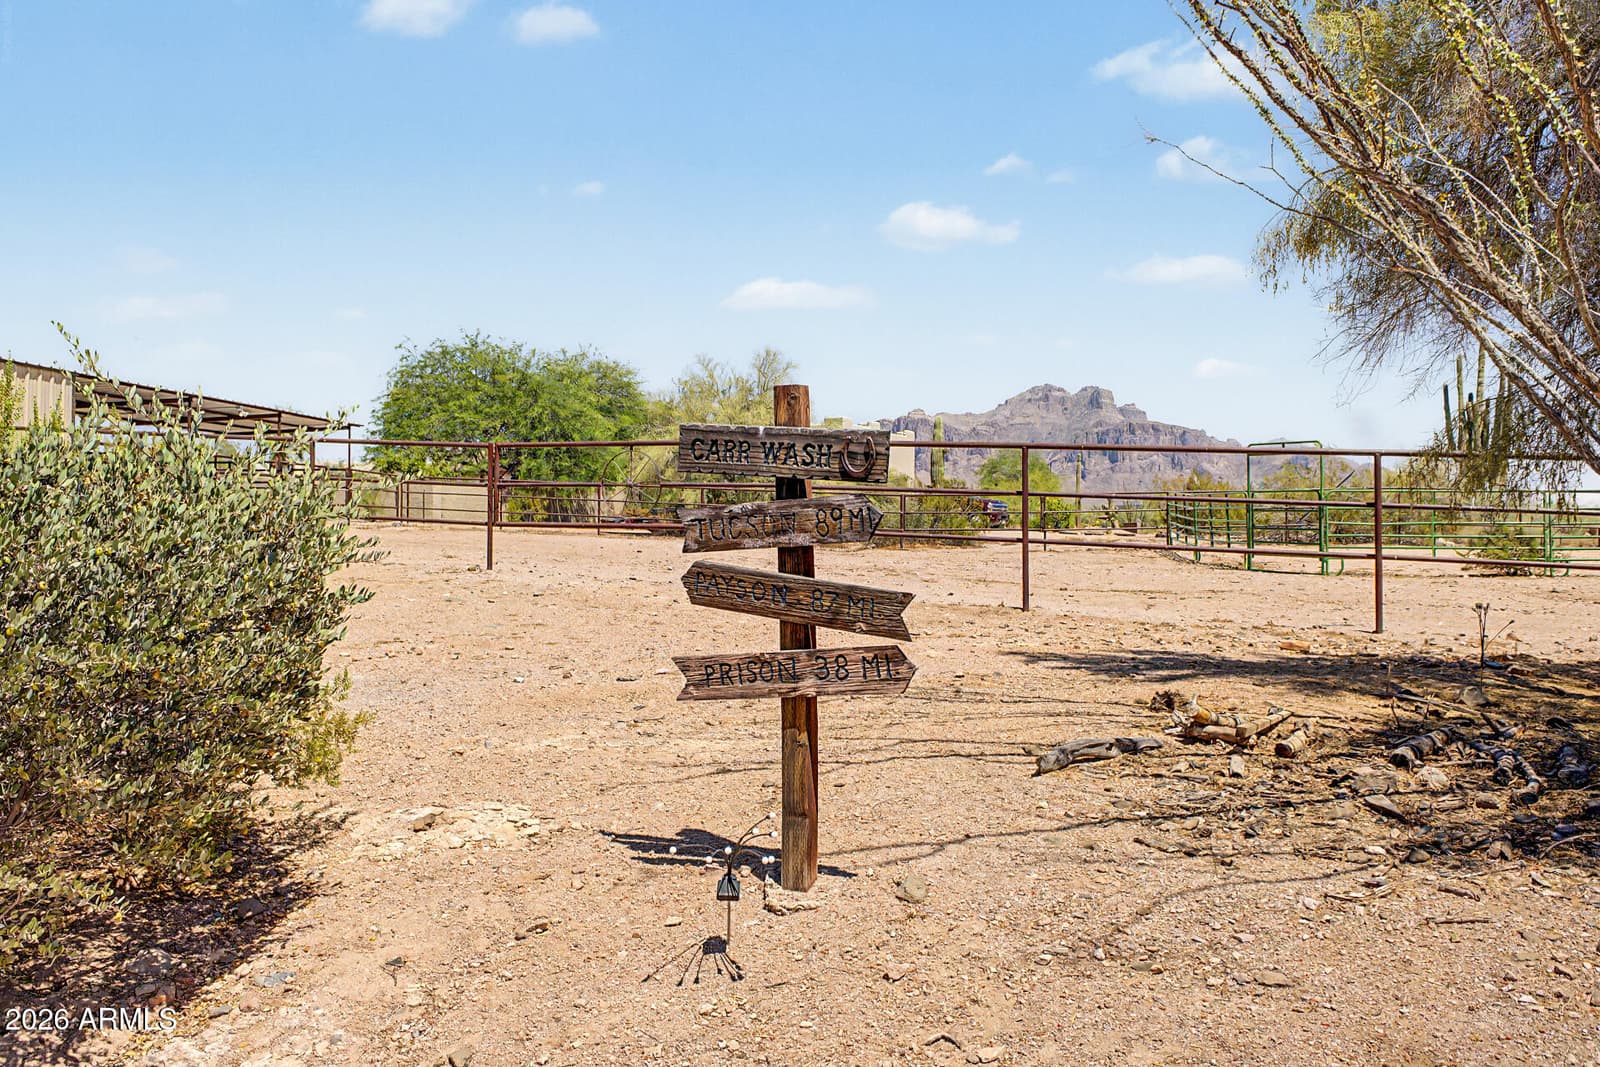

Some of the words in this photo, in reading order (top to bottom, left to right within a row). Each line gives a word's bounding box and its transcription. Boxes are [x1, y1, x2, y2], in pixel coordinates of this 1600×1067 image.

[690, 438, 751, 464] CARR
[760, 441, 833, 468] WASH
[684, 512, 796, 541] TUCSON
[815, 507, 843, 537] 89
[695, 571, 789, 607] PAYSON
[811, 588, 840, 614] 87
[704, 657, 799, 688] PRISON
[814, 653, 850, 681] 38
